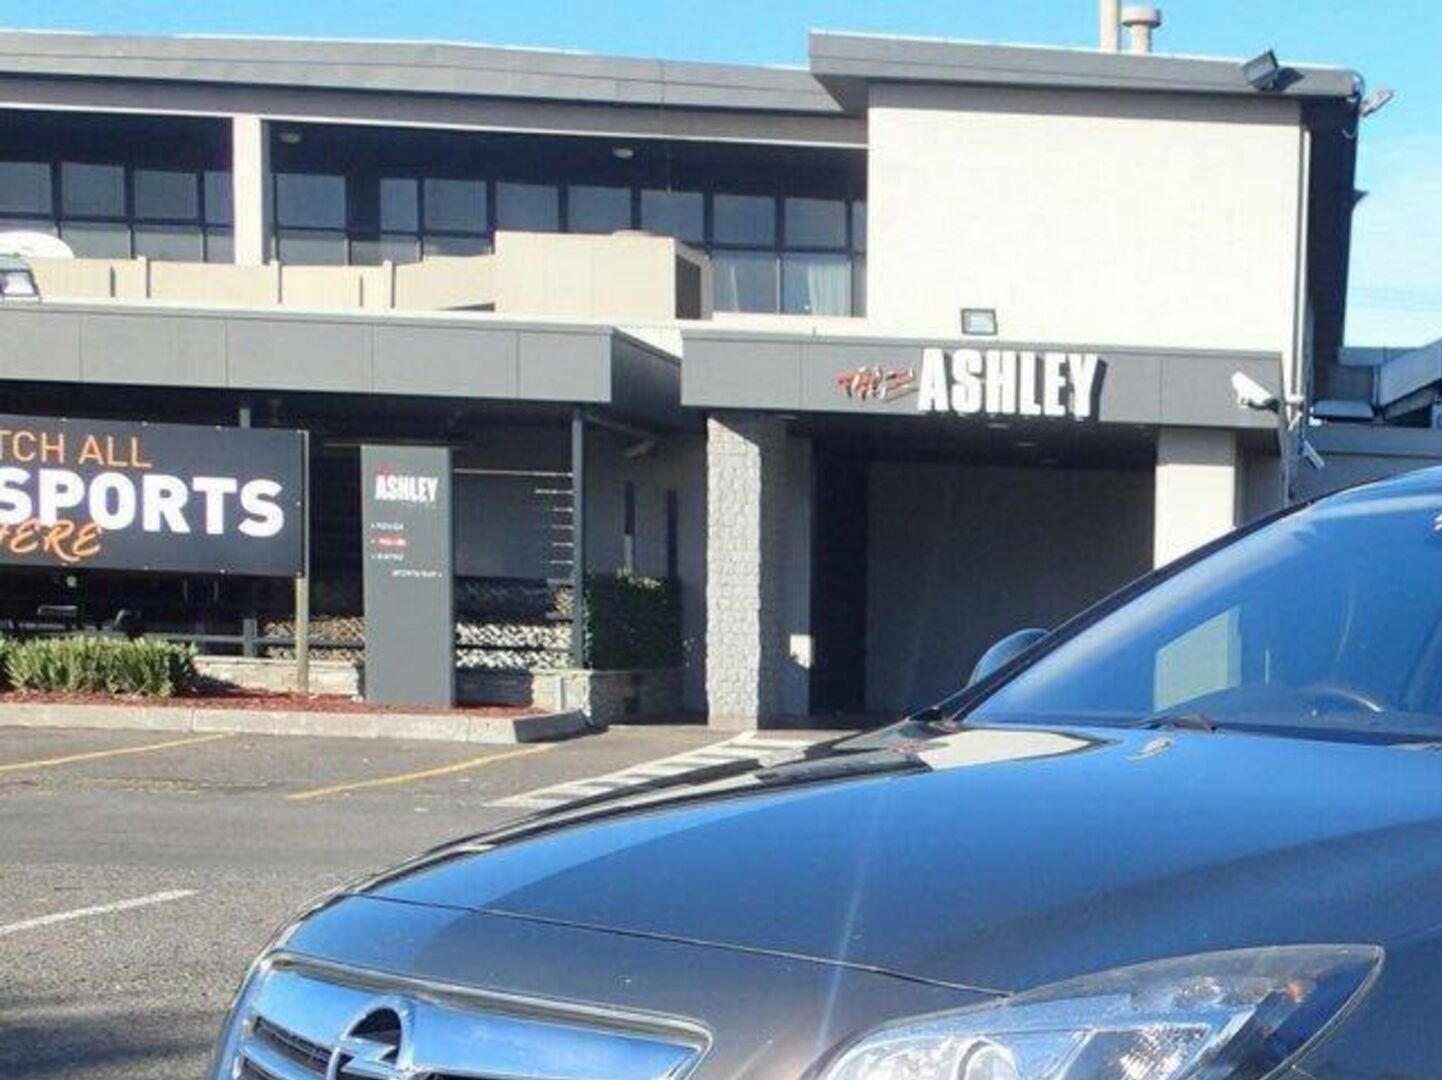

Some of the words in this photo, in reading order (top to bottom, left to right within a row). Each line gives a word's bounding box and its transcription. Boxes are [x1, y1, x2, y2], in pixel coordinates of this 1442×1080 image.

[917, 348, 1098, 417] ASHLEY
[79, 434, 152, 467] ALL
[0, 466, 284, 537] SPORTS
[375, 474, 438, 503] ASHLEY
